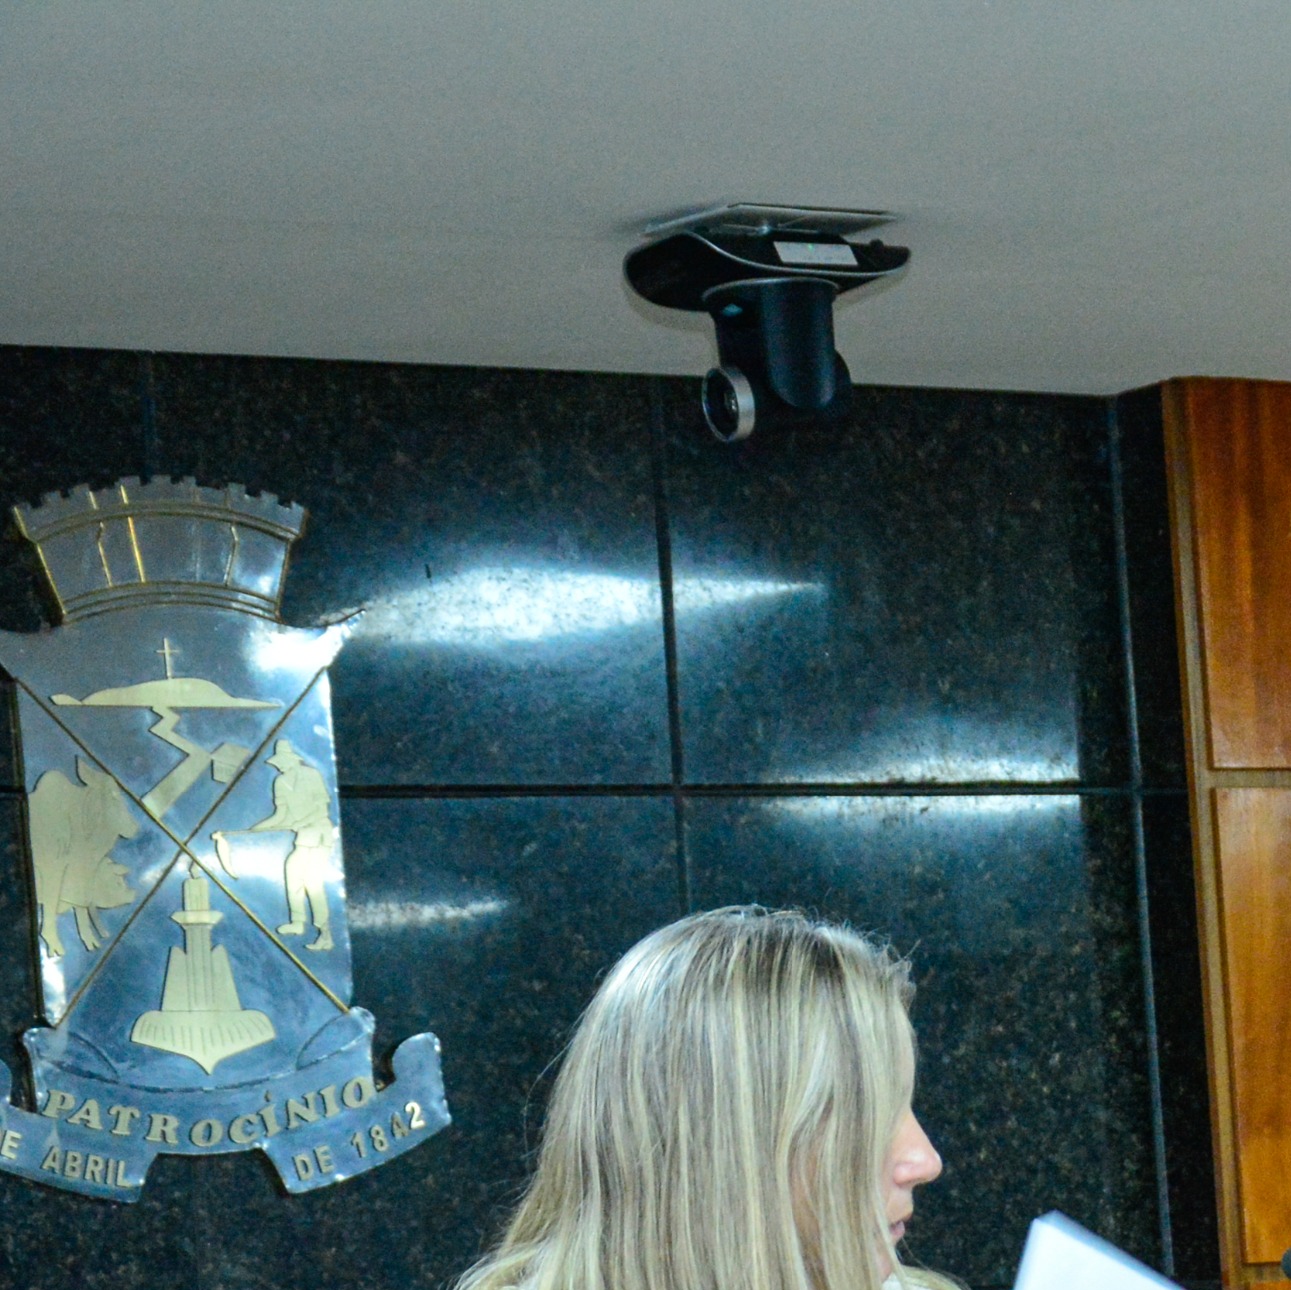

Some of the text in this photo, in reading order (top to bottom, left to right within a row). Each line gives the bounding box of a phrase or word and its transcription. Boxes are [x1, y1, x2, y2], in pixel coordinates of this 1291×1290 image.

[41, 1077, 377, 1147] PATROCÍNIO
[41, 1146, 132, 1188] ABRIL
[292, 1145, 335, 1181] DE
